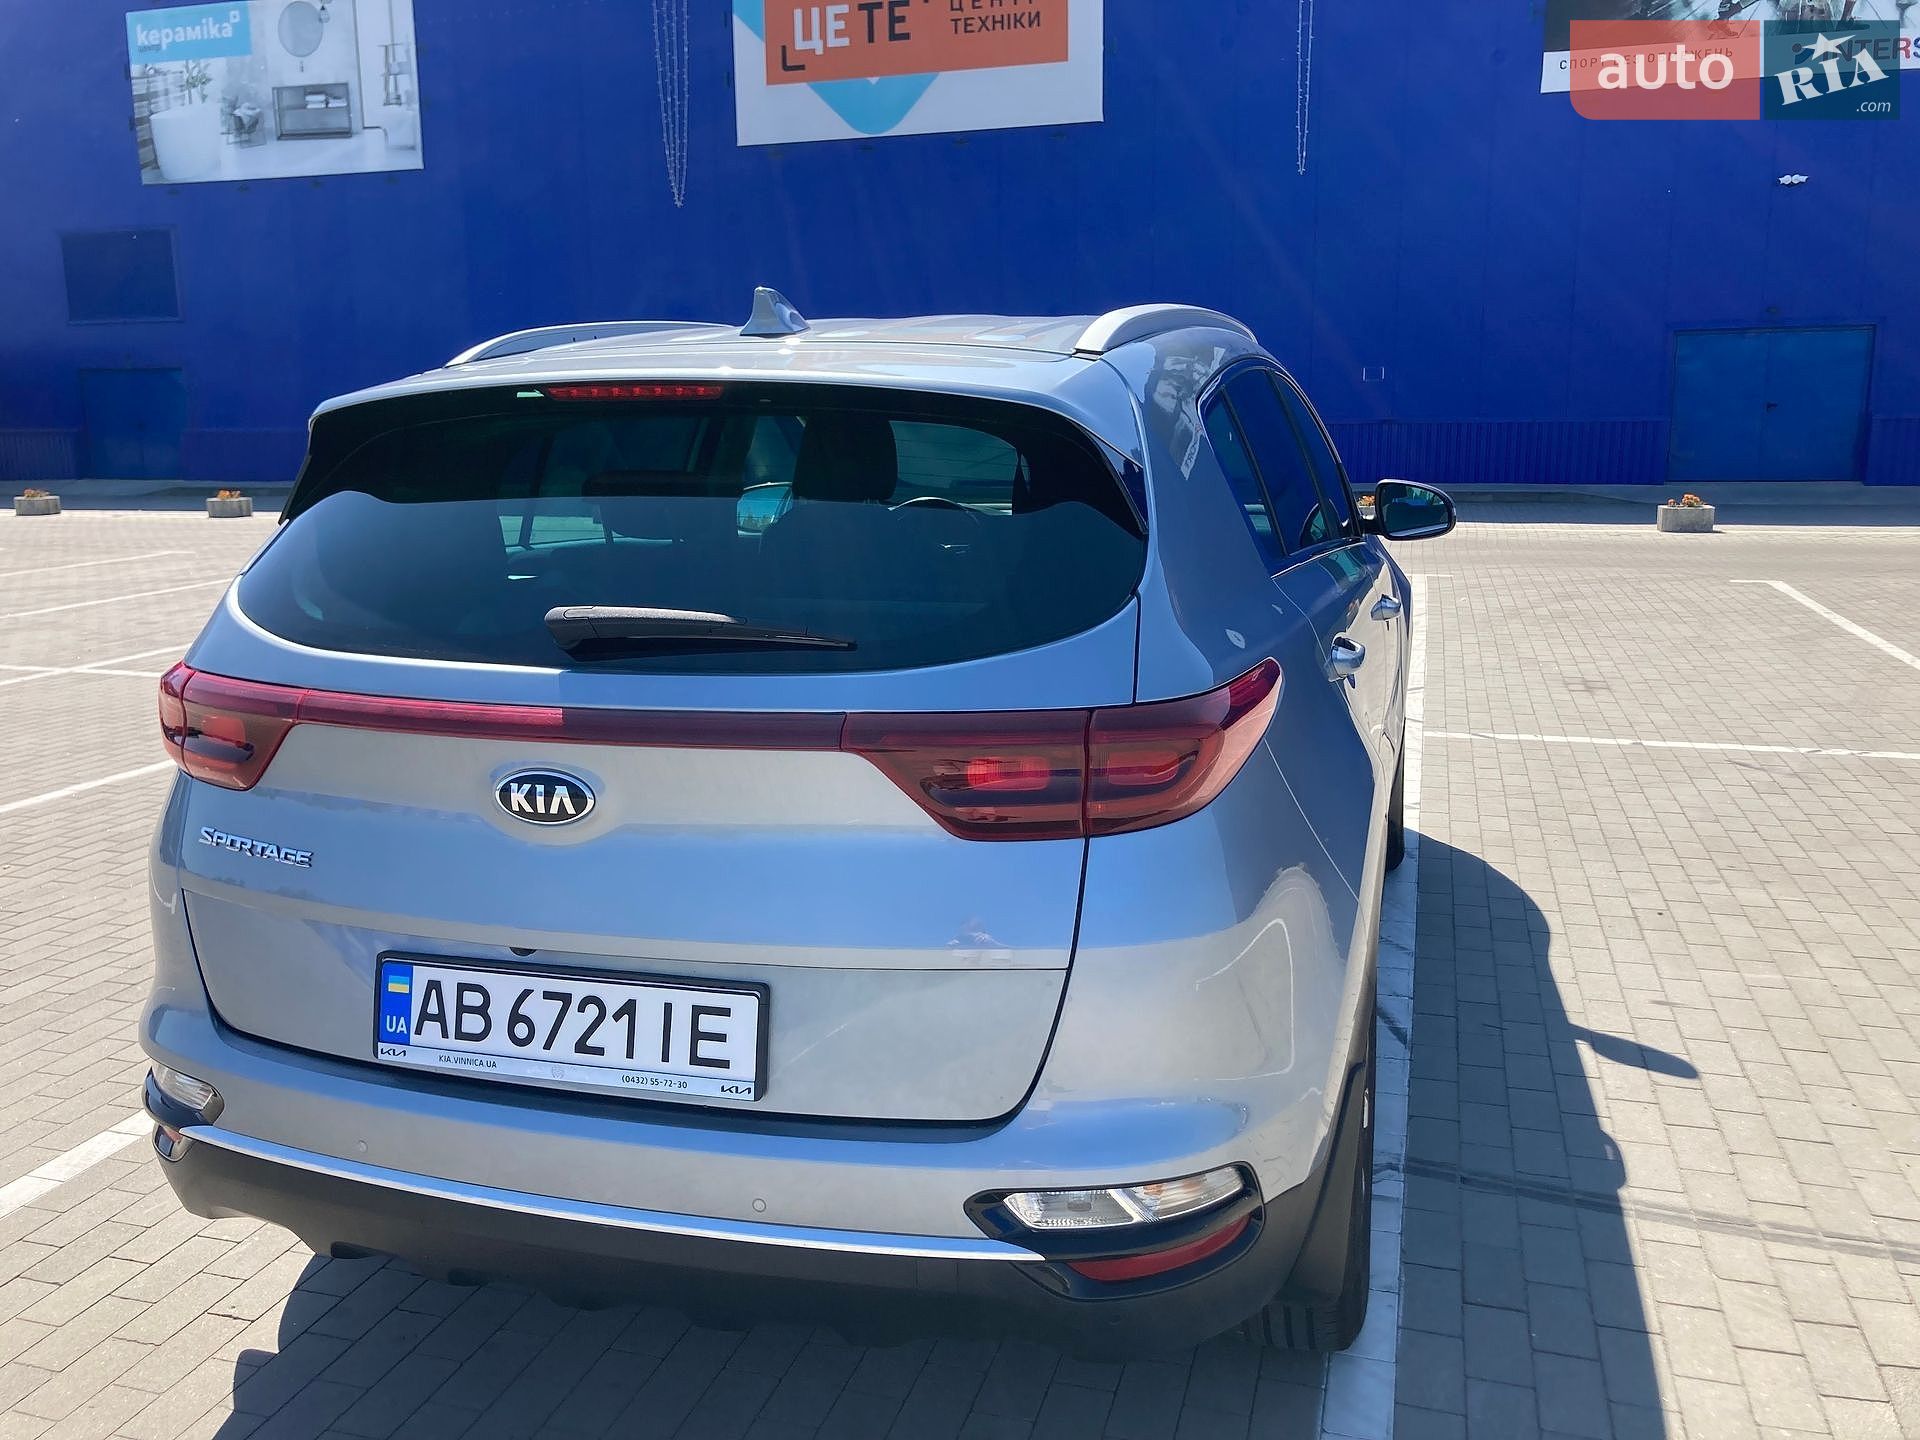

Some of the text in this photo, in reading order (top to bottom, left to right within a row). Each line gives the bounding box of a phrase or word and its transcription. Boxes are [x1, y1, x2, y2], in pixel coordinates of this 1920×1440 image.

[950, 11, 1041, 34] ТЕХНІКИ
[510, 782, 577, 815] KIA
[198, 826, 314, 869] SPORTAGE
[386, 1014, 408, 1035] UA
[414, 979, 731, 1070] AB 6721 IE
[621, 1075, 688, 1089] (0432) 55-72-30
